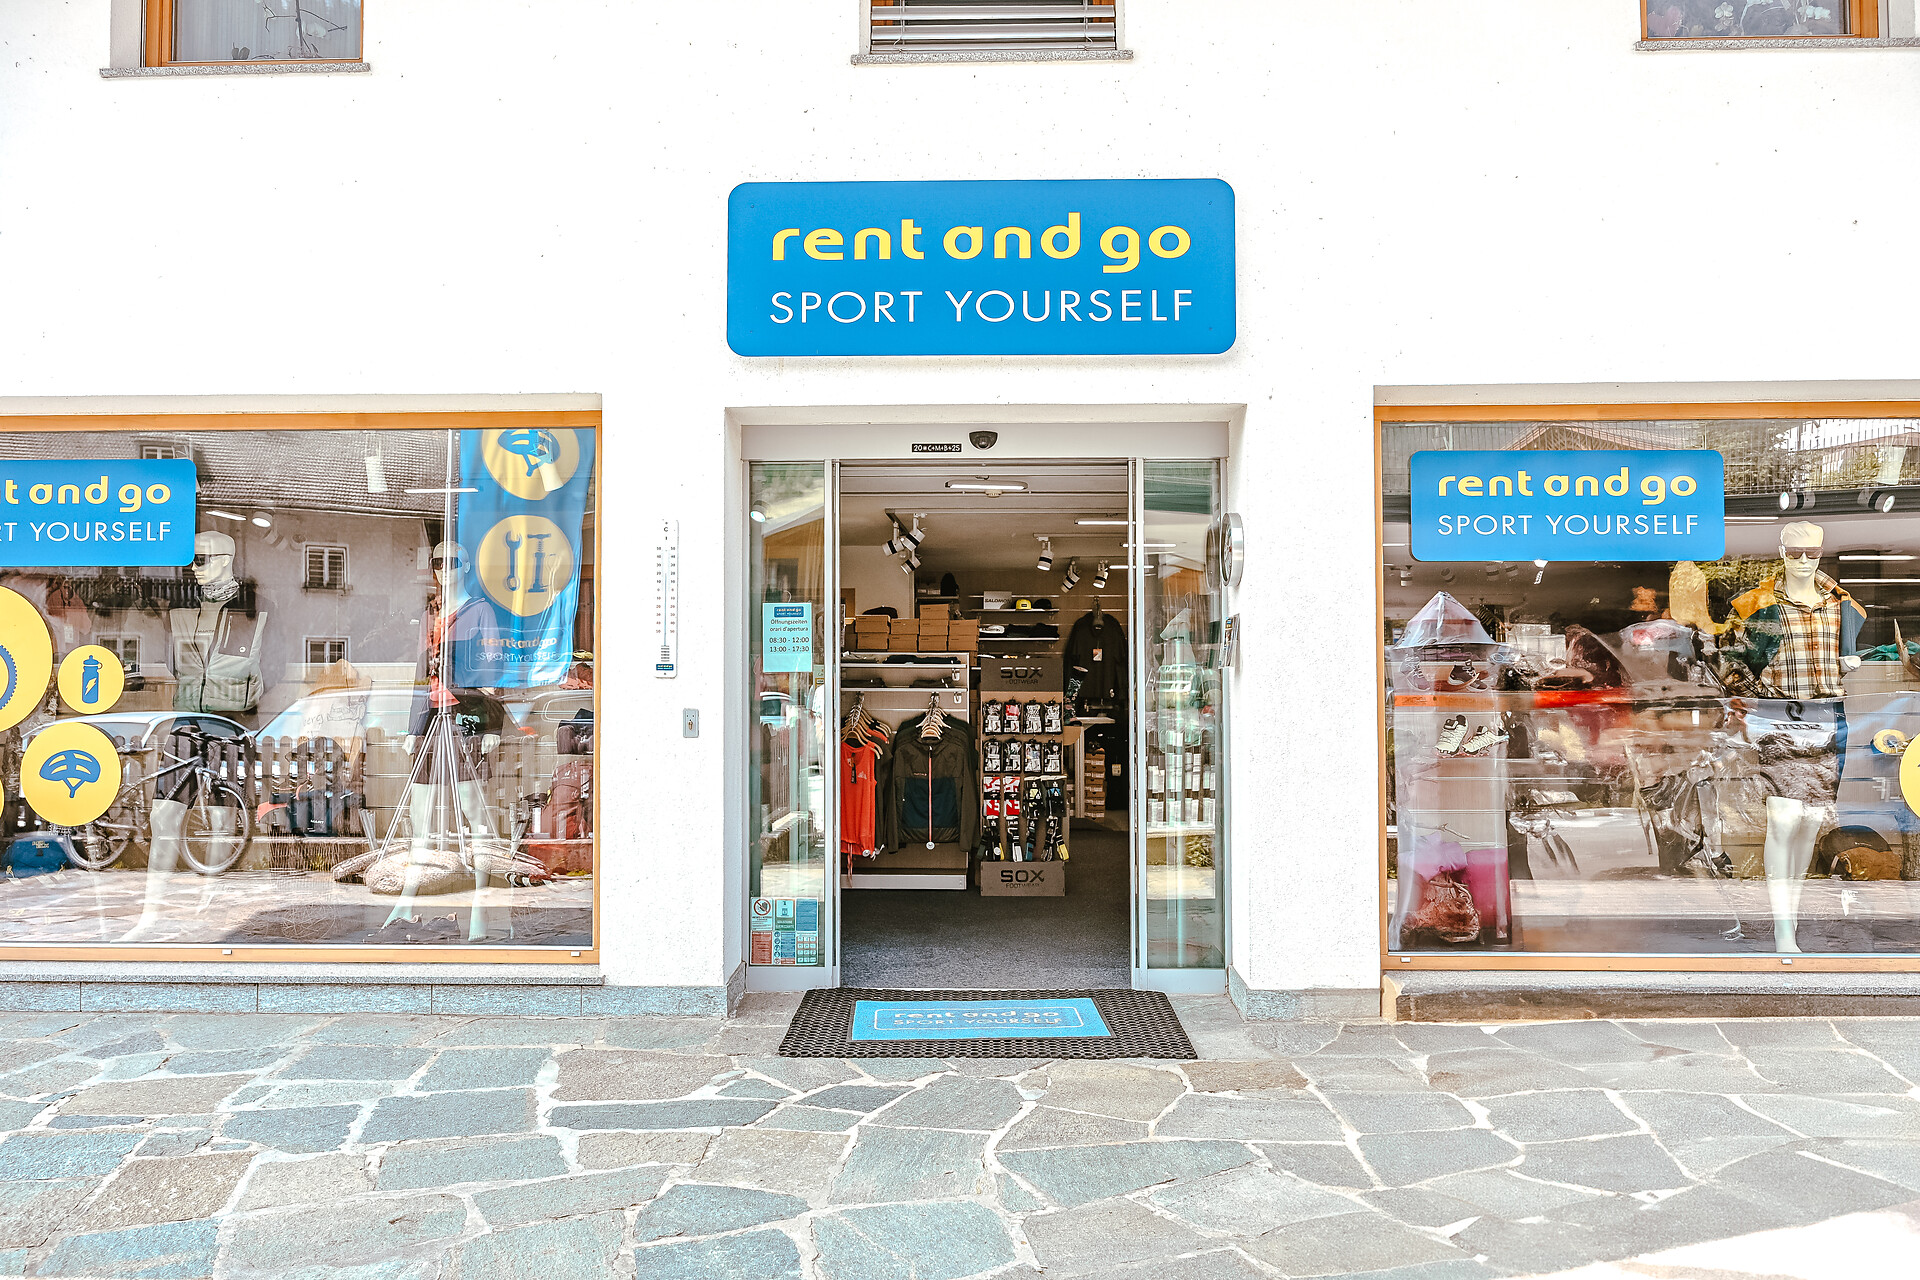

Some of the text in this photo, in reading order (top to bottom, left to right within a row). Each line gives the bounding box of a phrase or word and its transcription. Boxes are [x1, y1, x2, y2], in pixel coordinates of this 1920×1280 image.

[772, 212, 1192, 274] rent and go
[769, 289, 1193, 324] SPORT YOURSELF
[29, 475, 109, 505] and
[118, 483, 171, 513] go
[1438, 467, 1697, 506] rent and go
[29, 521, 171, 542] YOURSELF
[1438, 514, 1698, 536] SPORT YOURSELF
[1000, 666, 1043, 679] SOX
[1000, 869, 1045, 883] SOX
[894, 1011, 955, 1019] rent
[962, 1010, 1016, 1018] and
